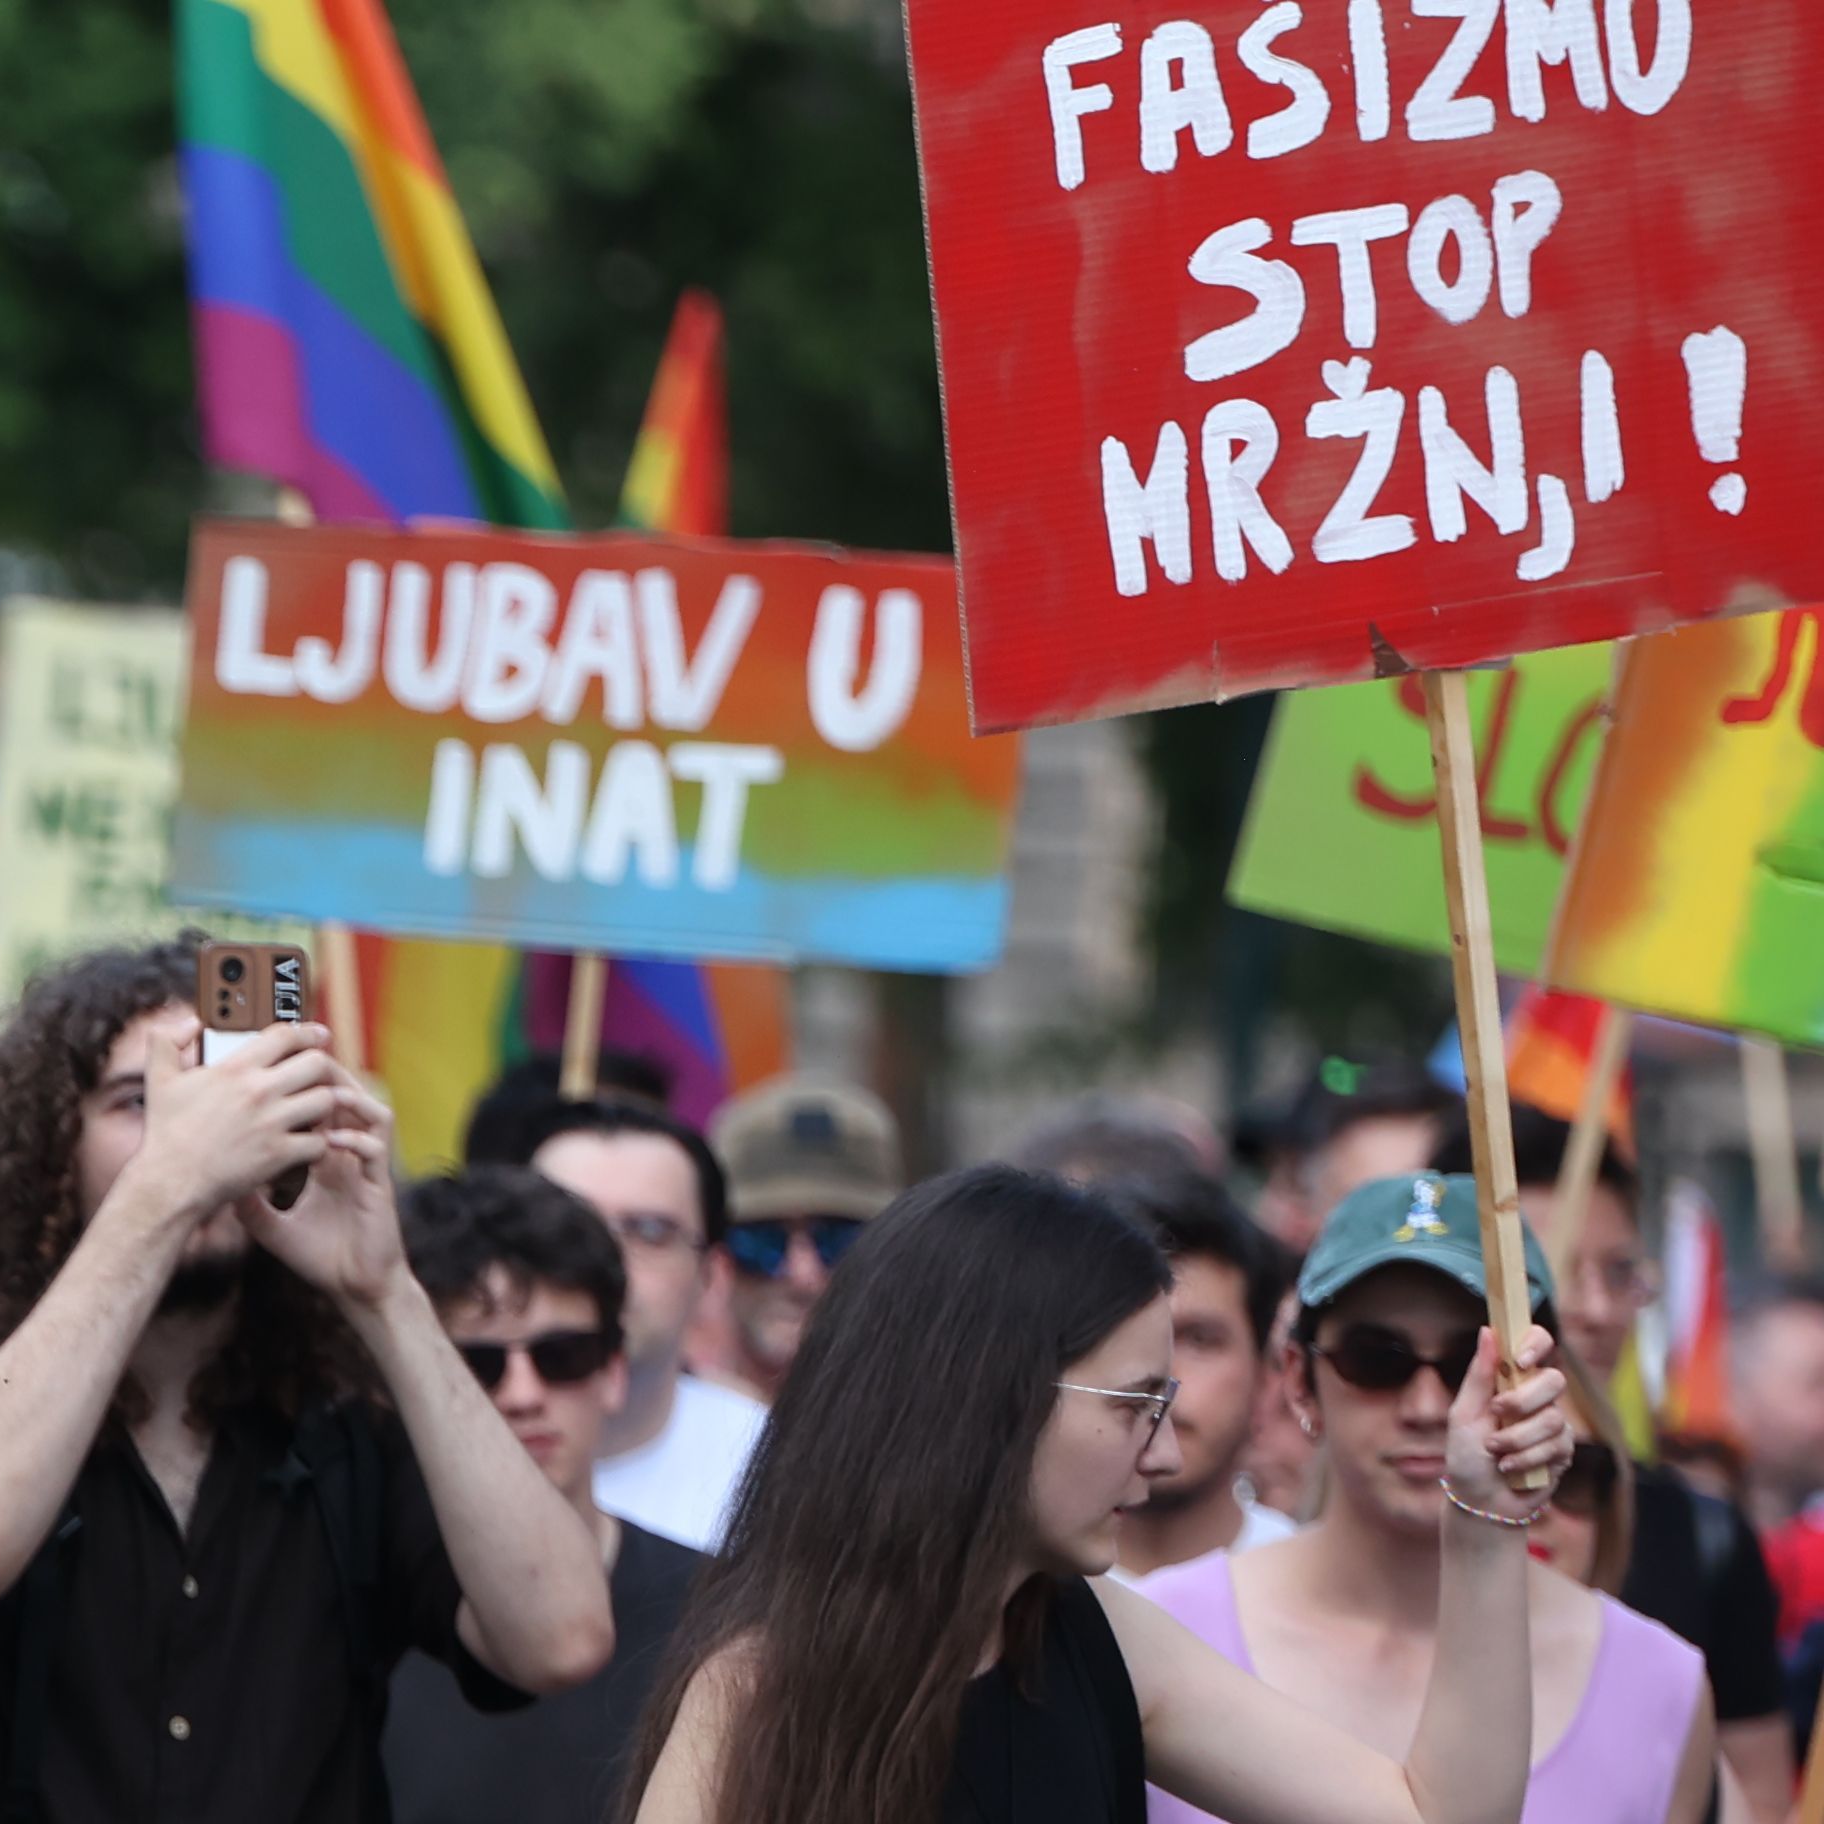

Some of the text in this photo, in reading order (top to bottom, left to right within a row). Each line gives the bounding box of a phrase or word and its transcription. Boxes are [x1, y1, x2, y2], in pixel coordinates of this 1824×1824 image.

[1183, 169, 1563, 382] STOP
[214, 554, 923, 753] LJUBAV U
[422, 737, 785, 892] INAT
